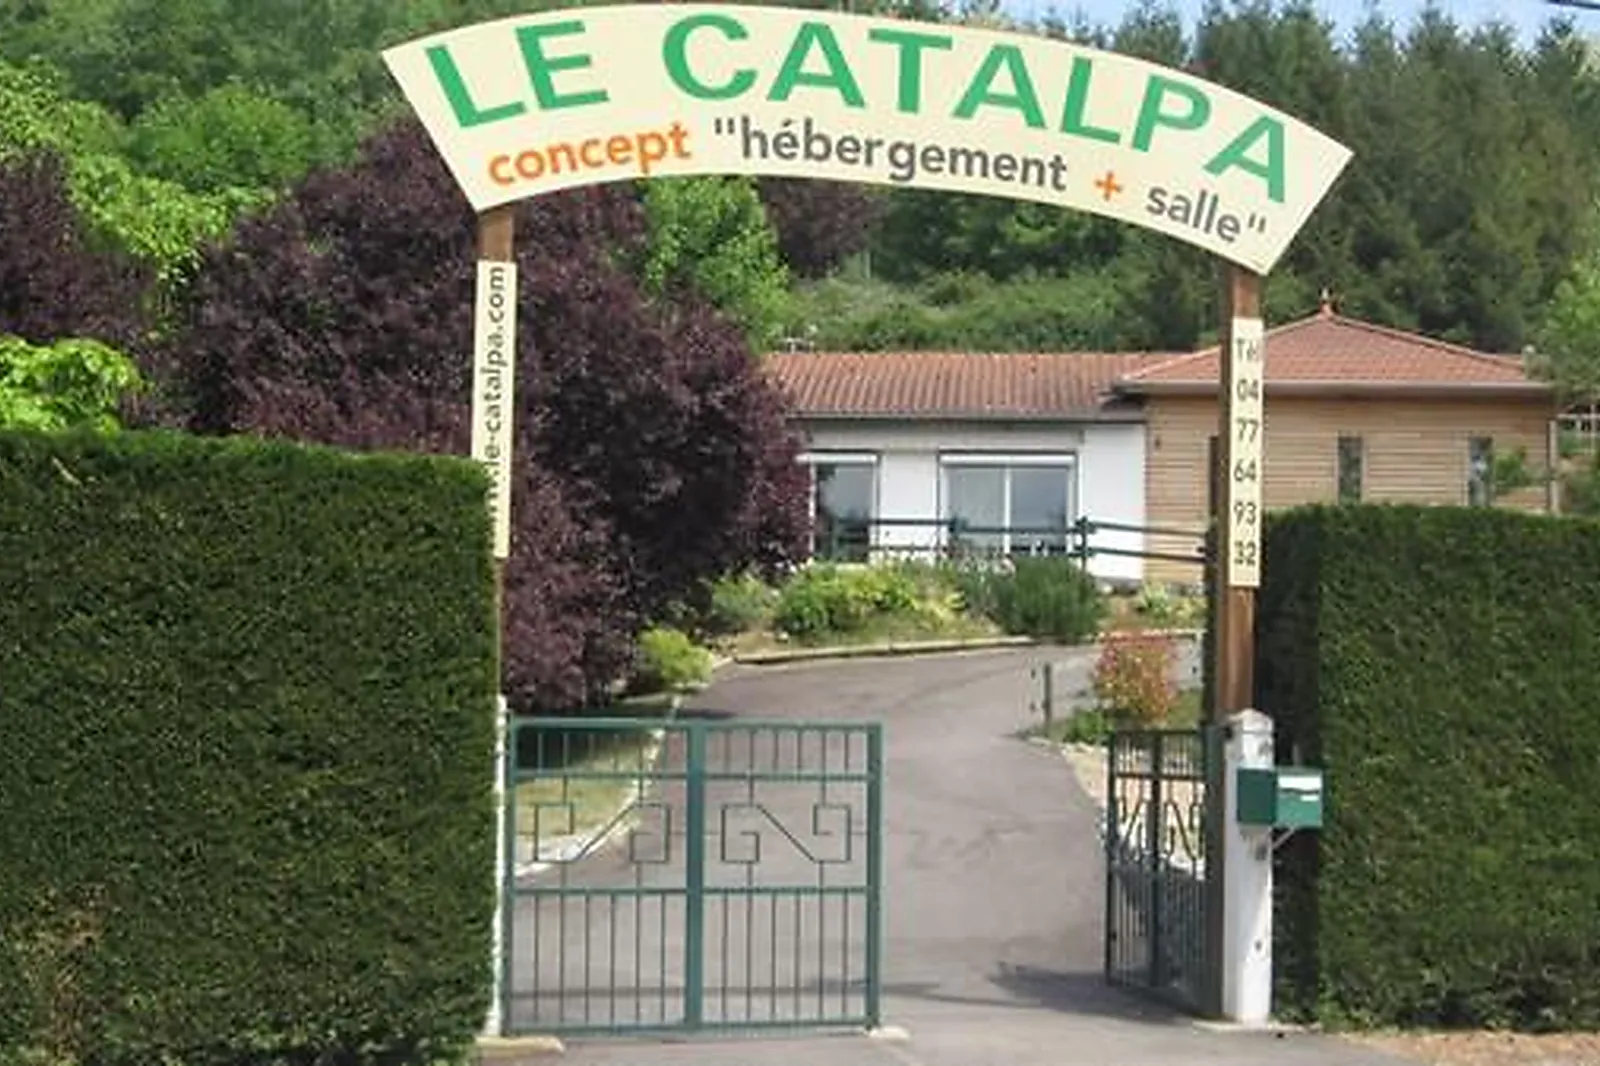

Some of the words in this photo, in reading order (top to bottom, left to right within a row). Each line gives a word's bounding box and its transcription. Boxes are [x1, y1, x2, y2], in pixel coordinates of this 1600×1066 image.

[425, 20, 609, 128] LE
[662, 13, 1286, 204] CATALPA
[488, 122, 692, 185] concept
[714, 114, 1068, 192] "hébergement
[1095, 171, 1122, 201] +
[1146, 182, 1267, 243] salle"
[1236, 378, 1259, 401] 04
[1236, 418, 1259, 441] 77
[1234, 458, 1257, 482] 64
[1234, 501, 1257, 526] 93
[1233, 540, 1257, 566] 32
